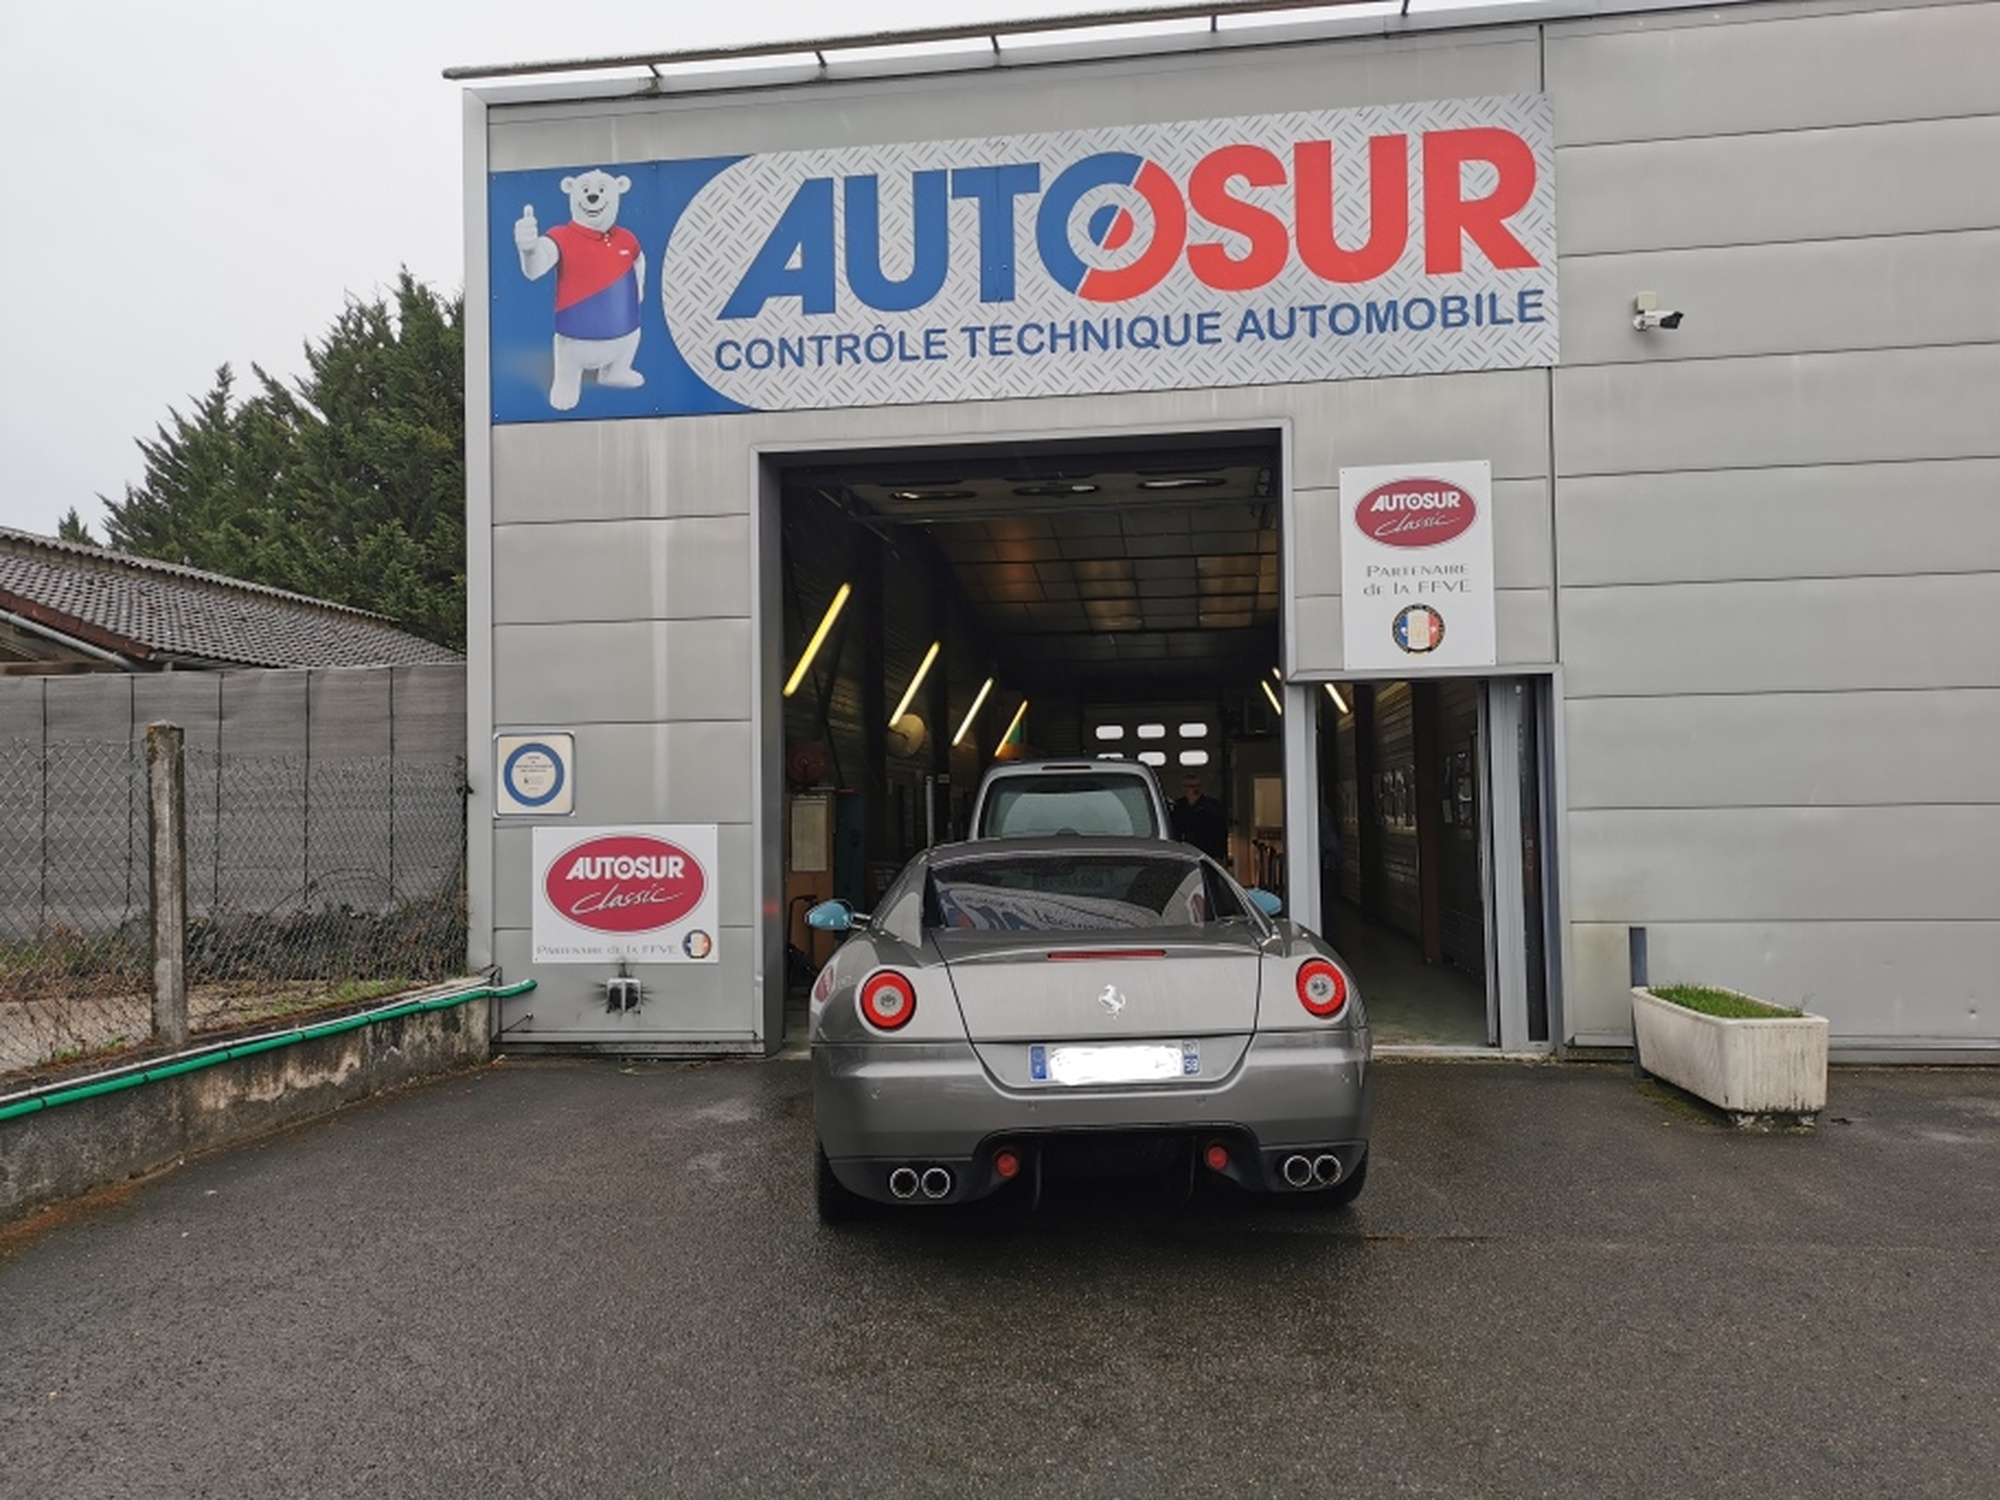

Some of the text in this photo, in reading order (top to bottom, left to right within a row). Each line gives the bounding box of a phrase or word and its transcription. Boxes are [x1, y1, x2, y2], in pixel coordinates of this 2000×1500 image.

[716, 127, 1541, 319] AUTOSUR
[715, 289, 1545, 372] CONTRÔLE TECHNIQUE AUTOMOBILE
[1370, 491, 1461, 512] AUTOSUR
[1374, 512, 1461, 536] Classic
[1418, 579, 1472, 594] FFVE
[565, 855, 685, 880] AUTOSUR
[571, 883, 684, 915] Classic
